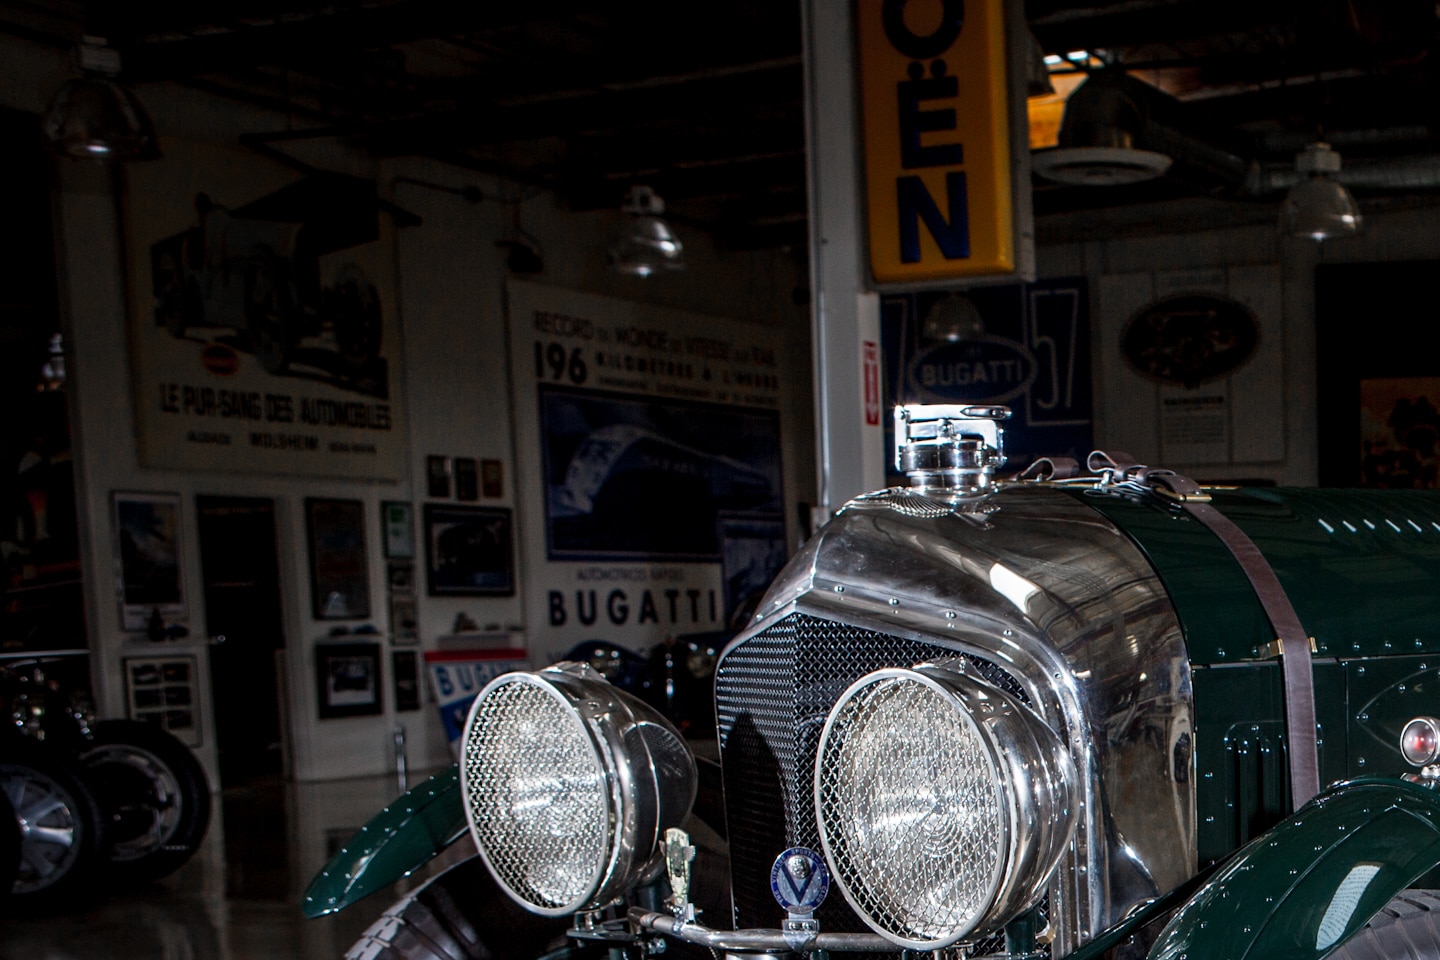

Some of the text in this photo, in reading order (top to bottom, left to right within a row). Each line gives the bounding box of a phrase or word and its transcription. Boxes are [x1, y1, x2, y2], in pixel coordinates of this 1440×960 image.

[534, 340, 588, 384] 196
[920, 359, 1023, 386] BUGATTI
[159, 382, 181, 414] LE
[300, 397, 393, 431] AUTOMOBILES
[549, 589, 717, 627] BUGATTI
